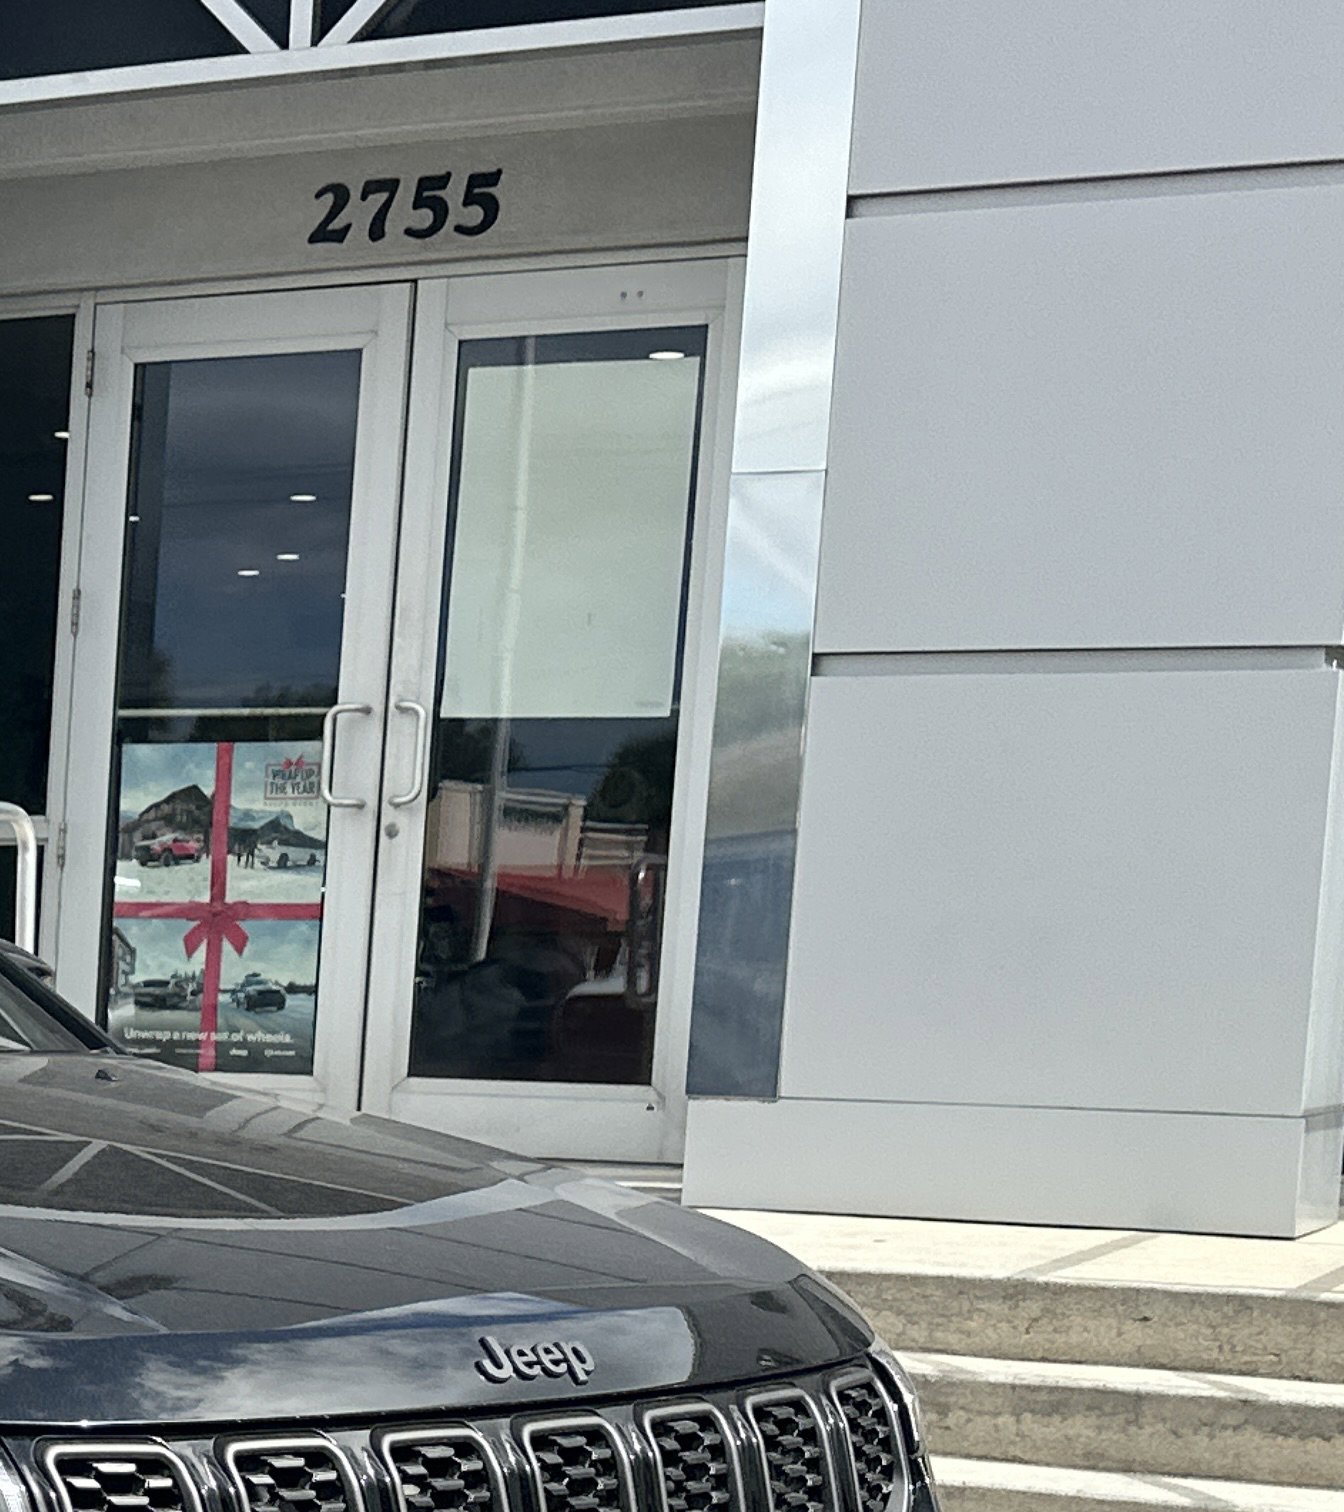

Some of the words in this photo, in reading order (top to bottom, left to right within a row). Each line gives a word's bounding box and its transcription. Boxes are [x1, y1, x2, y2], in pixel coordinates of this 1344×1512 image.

[308, 168, 503, 244] 2755
[269, 781, 288, 796] THE
[291, 781, 316, 795] YEAR
[123, 1026, 171, 1042] Unwrap
[231, 1029, 244, 1042] of
[474, 1336, 595, 1386] Jeep
